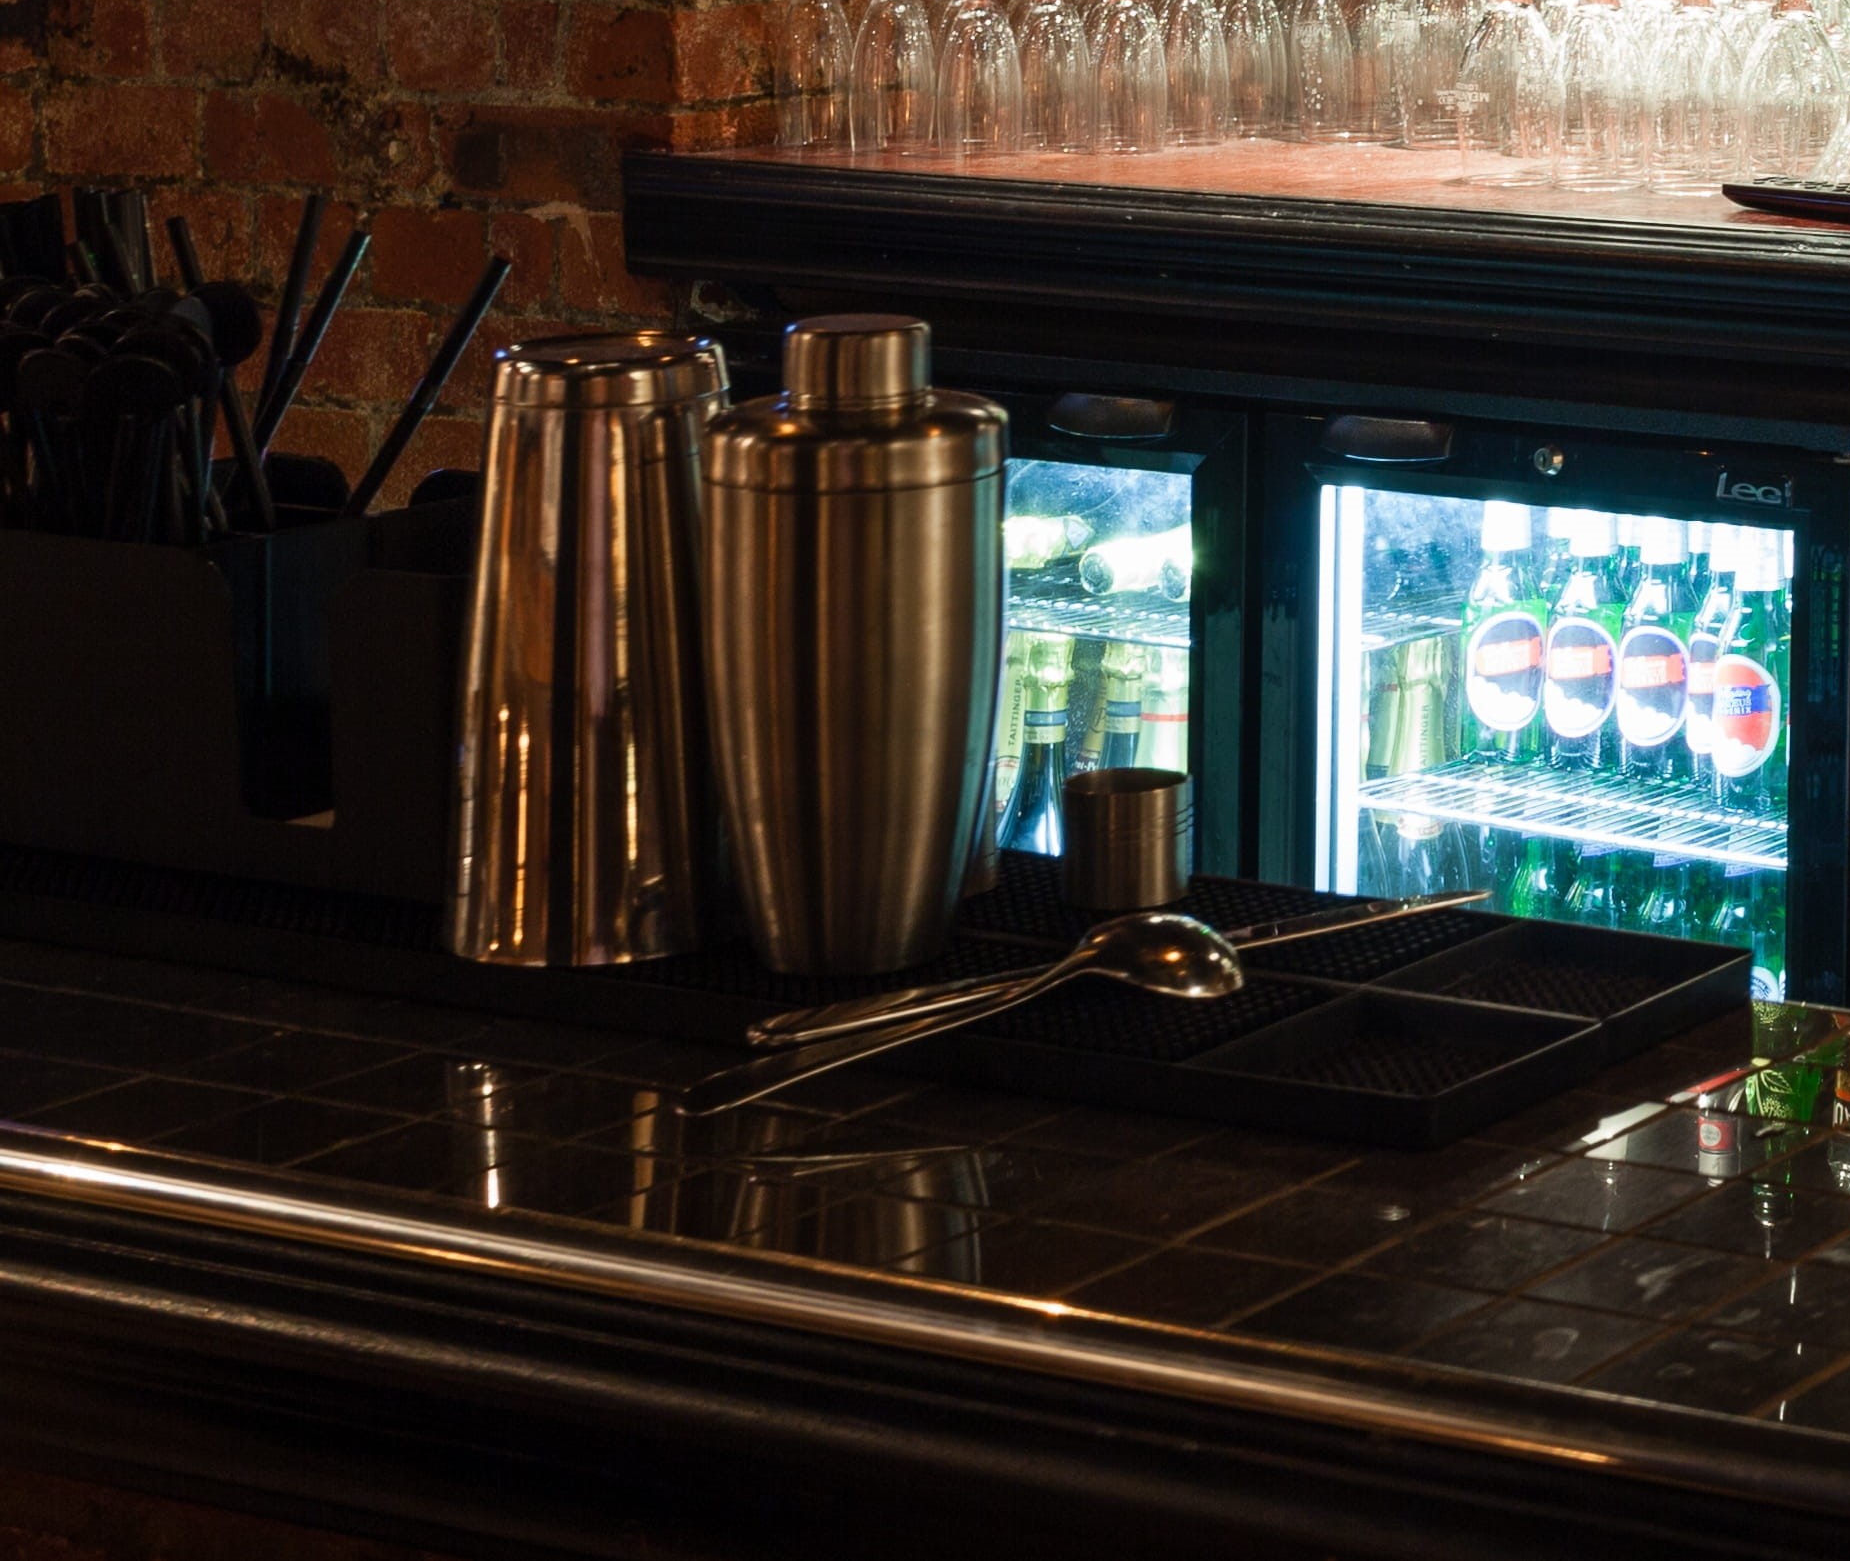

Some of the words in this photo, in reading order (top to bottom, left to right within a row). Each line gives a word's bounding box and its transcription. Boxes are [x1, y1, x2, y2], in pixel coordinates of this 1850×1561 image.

[1716, 472, 1782, 504] Lec
[1008, 678, 1022, 747] TAITTINGER
[1420, 703, 1431, 767] AITTINGER
